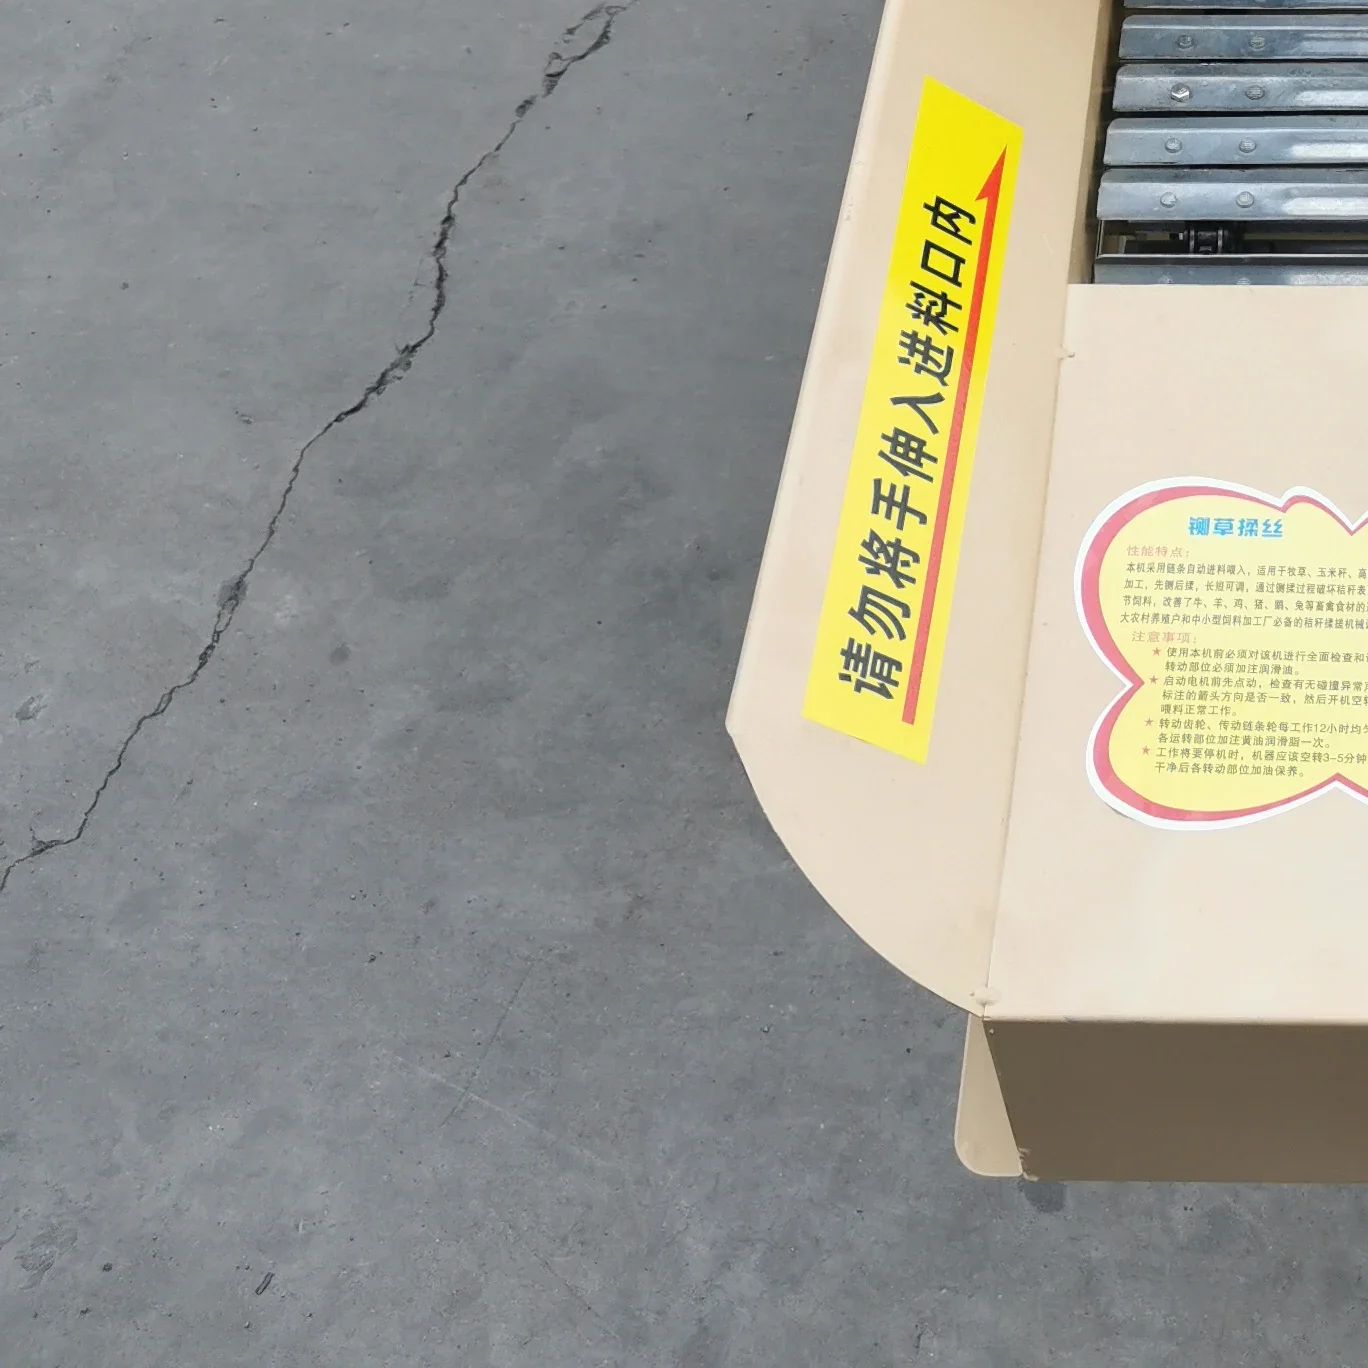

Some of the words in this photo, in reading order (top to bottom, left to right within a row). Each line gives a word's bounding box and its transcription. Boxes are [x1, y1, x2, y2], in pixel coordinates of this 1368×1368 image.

[838, 193, 977, 701] 请勿将手伸入进料口内
